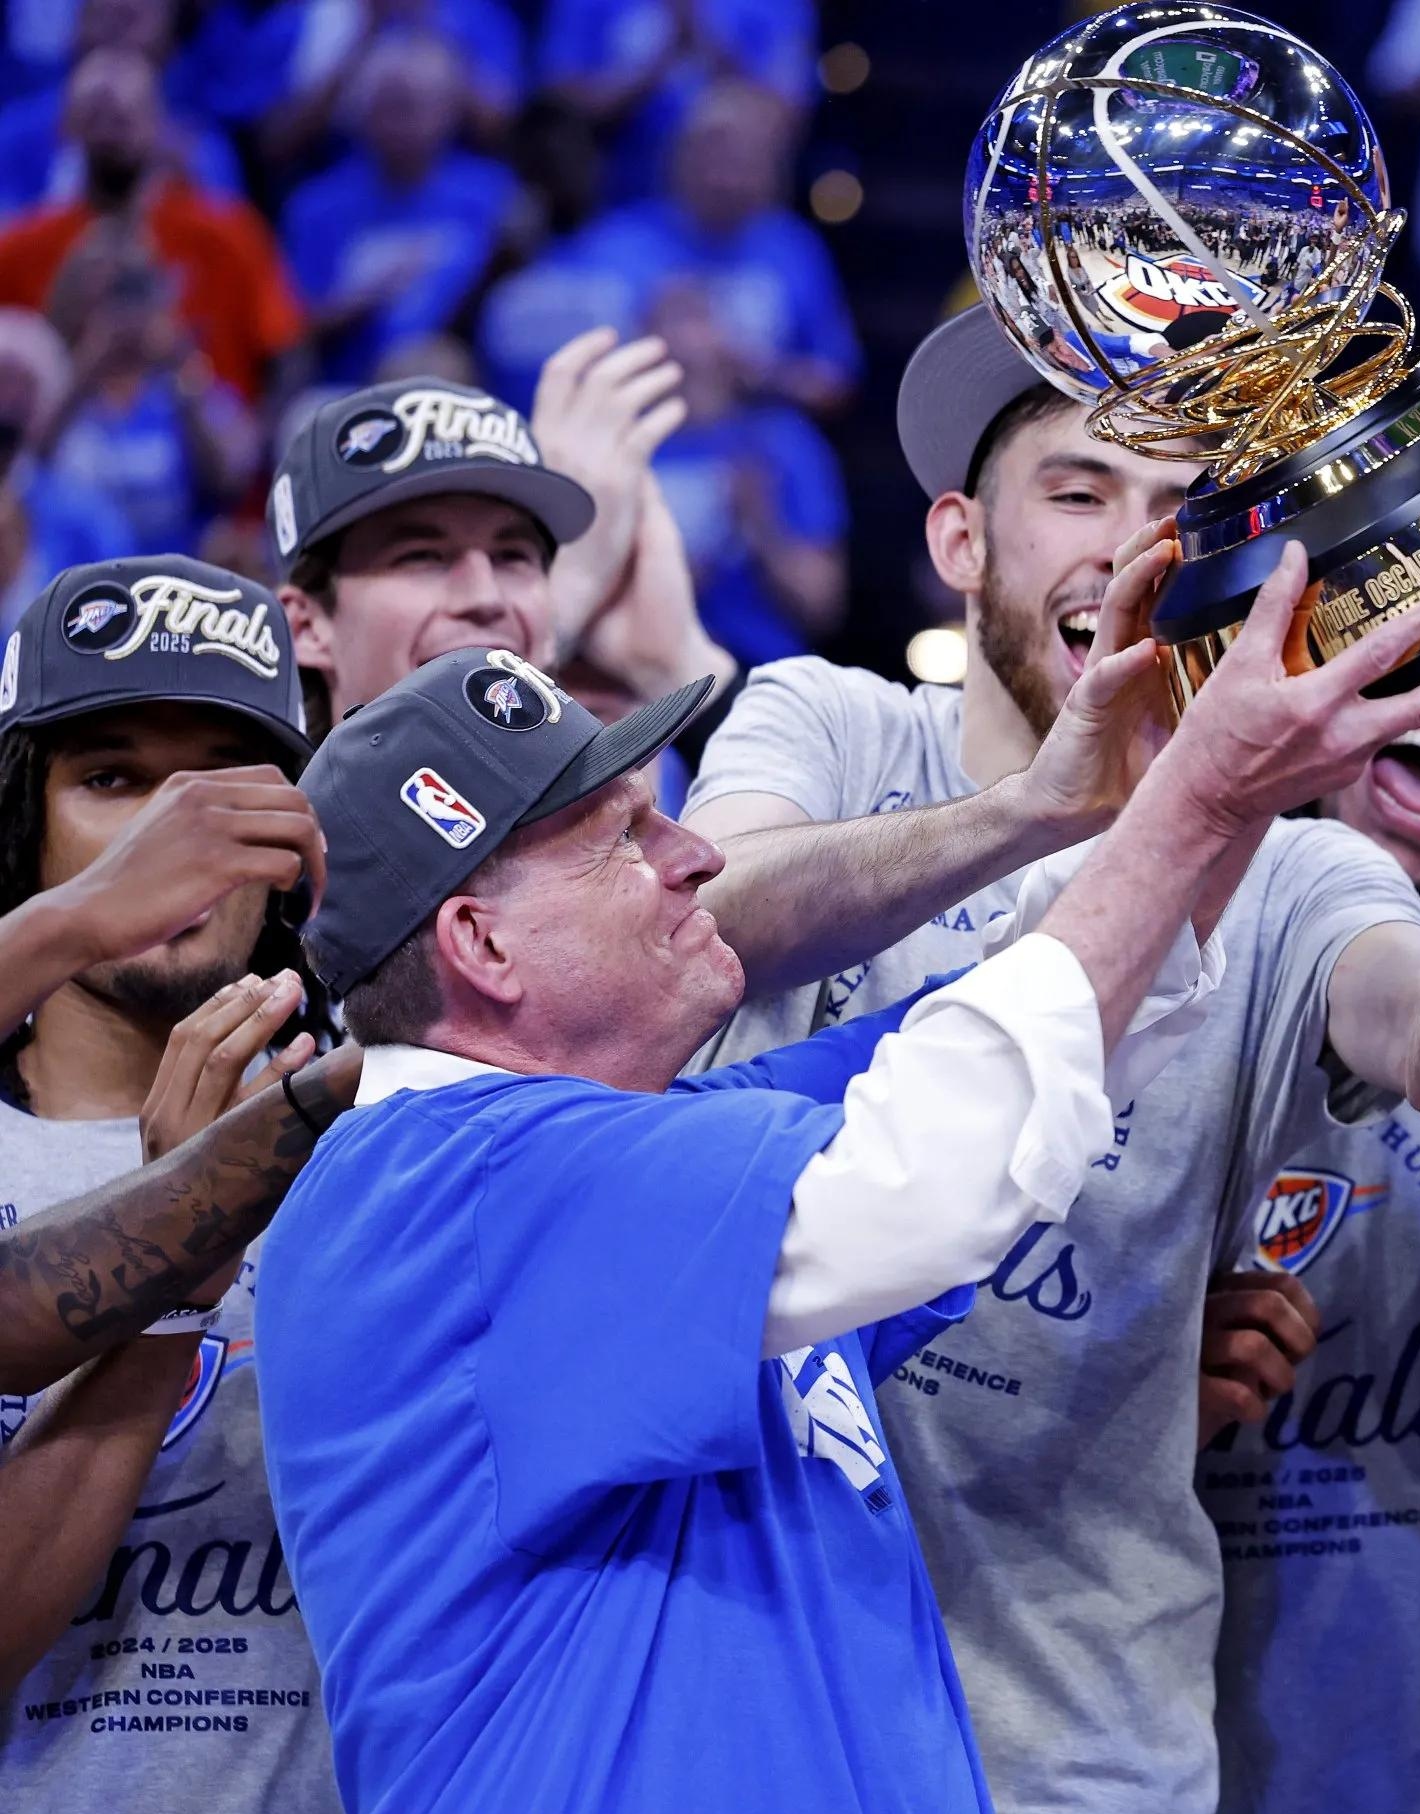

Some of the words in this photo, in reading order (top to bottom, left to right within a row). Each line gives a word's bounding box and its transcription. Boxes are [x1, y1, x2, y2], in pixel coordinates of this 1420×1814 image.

[382, 389, 540, 474] Finals
[104, 575, 281, 679] Finals
[150, 632, 191, 654] 2025
[912, 1349, 1022, 1397] ERENCE
[90, 1637, 155, 1661] 2024
[178, 1638, 249, 1654] 2025
[141, 1664, 195, 1680] NBA
[24, 1689, 141, 1721] WESTERN
[146, 1689, 311, 1708] CONFERENCE
[90, 1715, 249, 1733] CHAMPIONS
